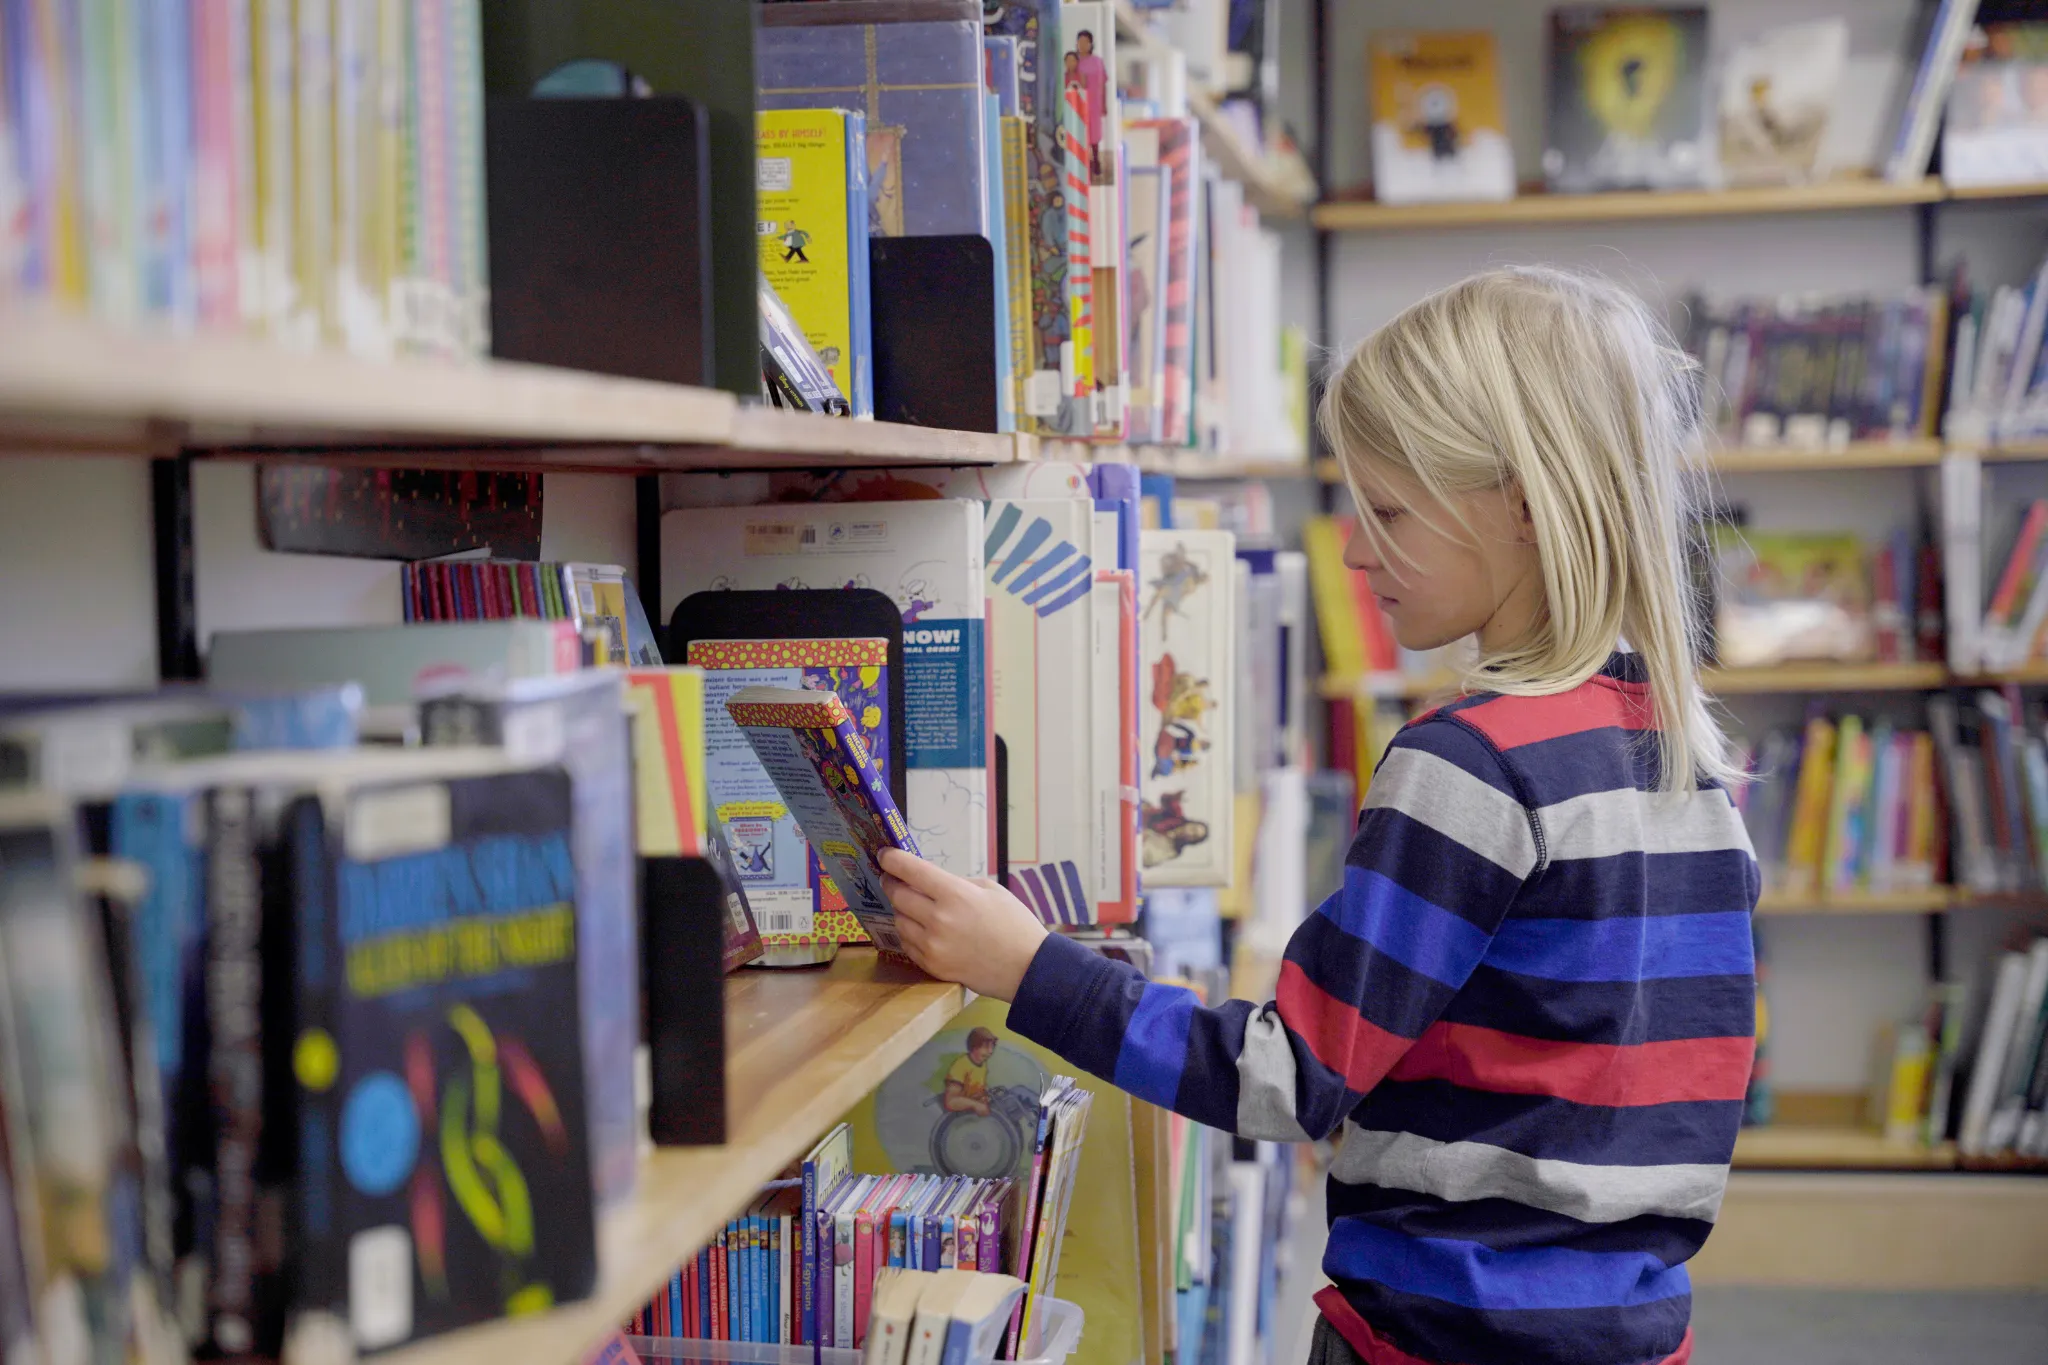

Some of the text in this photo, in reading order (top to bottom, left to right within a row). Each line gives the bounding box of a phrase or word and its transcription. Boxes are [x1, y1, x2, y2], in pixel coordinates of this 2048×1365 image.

[778, 129, 788, 138] BY
[902, 629, 960, 645] NOW!
[844, 734, 866, 769] TOWNSEND
[851, 732, 868, 763] MICHAEL
[886, 814, 904, 840] WONDER
[890, 808, 908, 836] AMAZING
[804, 1262, 813, 1311] Egyptians
[840, 1284, 848, 1300] The
[840, 1302, 848, 1324] story
[840, 1325, 848, 1335] of
